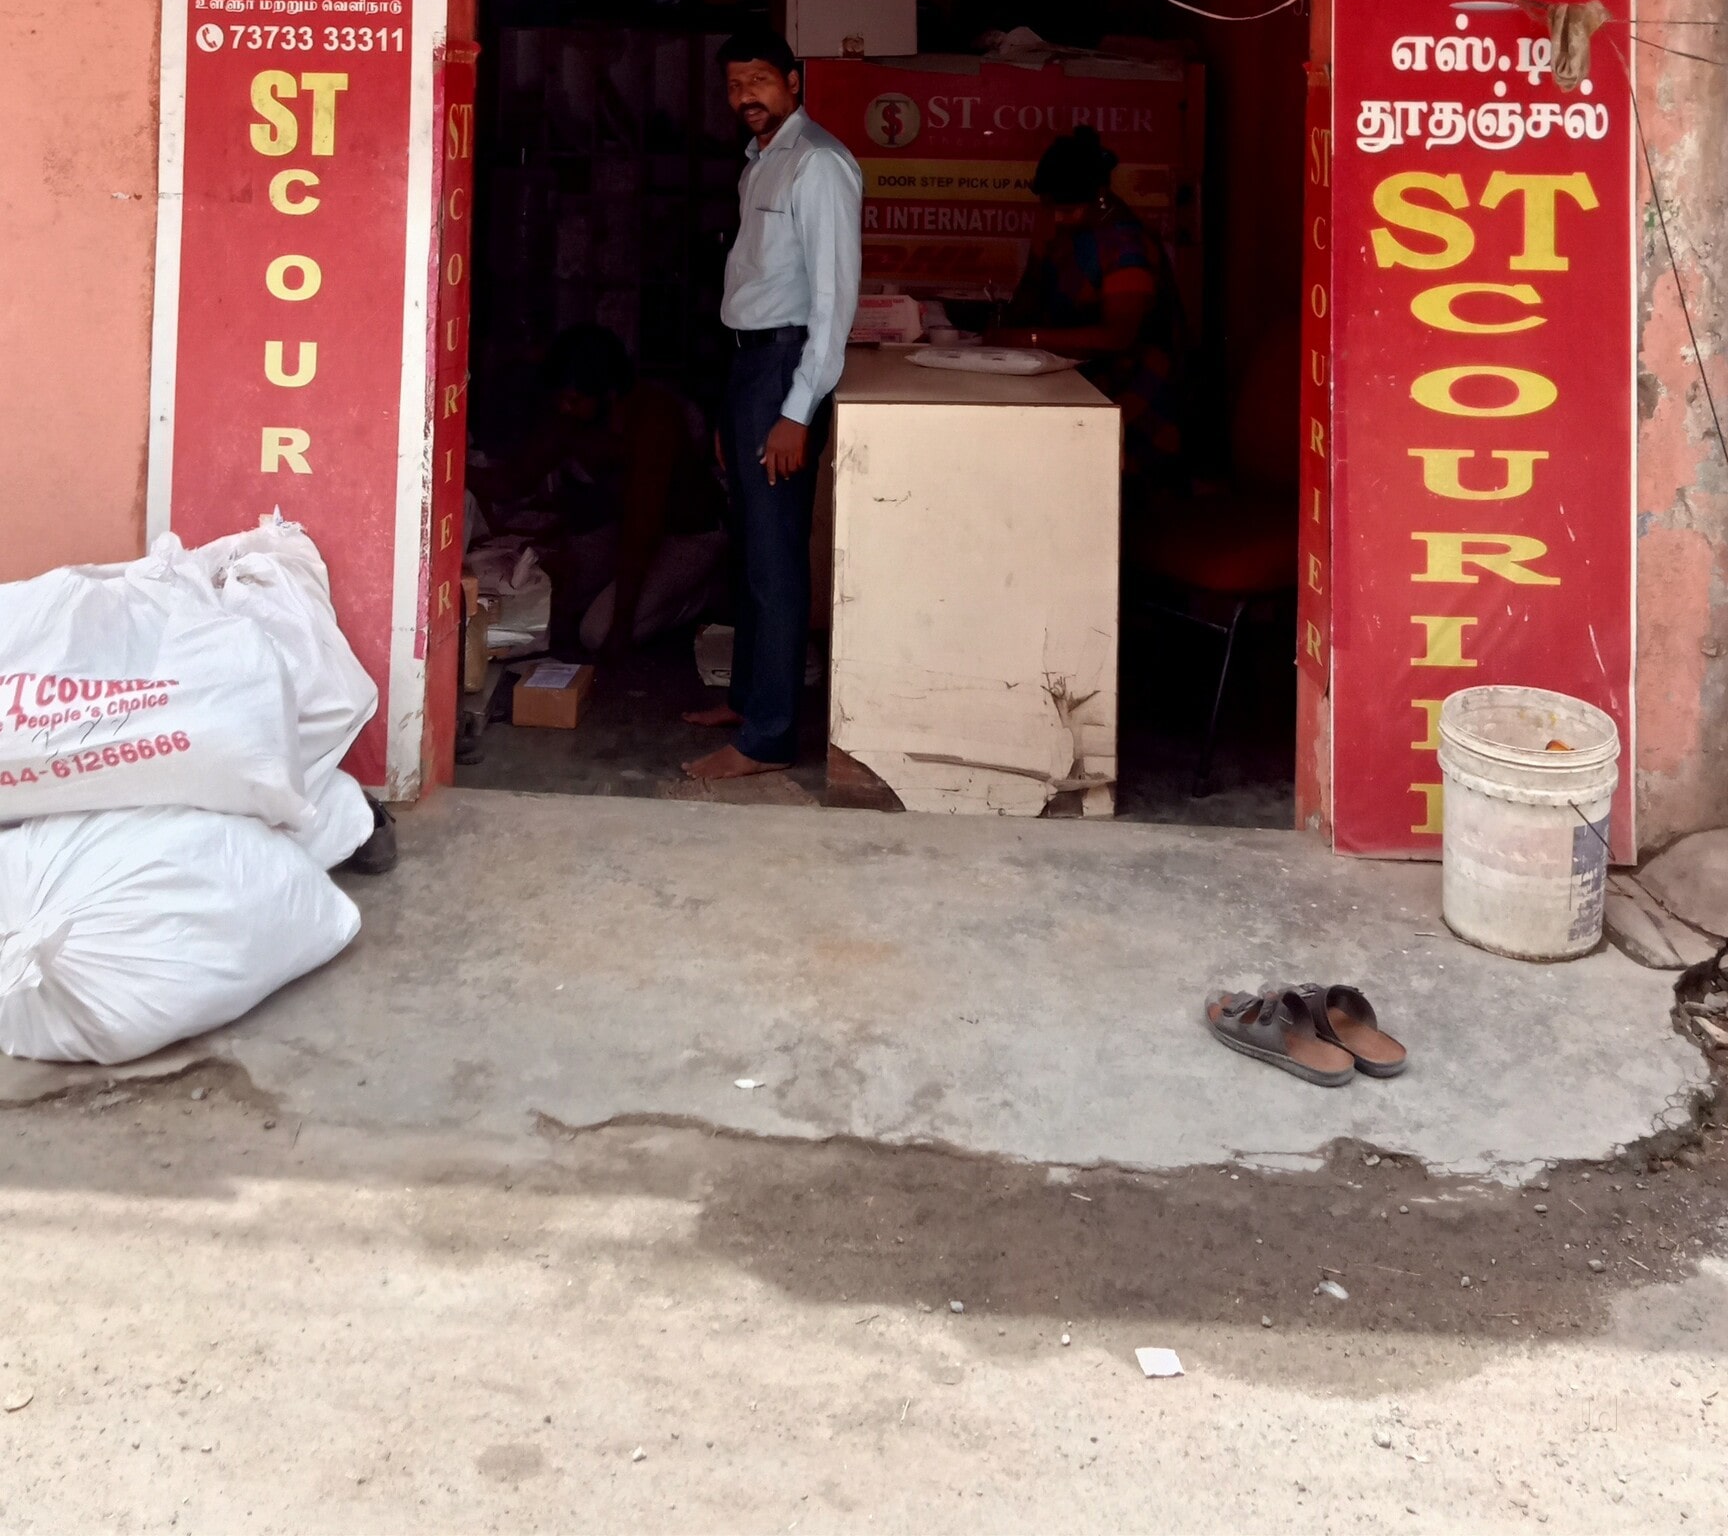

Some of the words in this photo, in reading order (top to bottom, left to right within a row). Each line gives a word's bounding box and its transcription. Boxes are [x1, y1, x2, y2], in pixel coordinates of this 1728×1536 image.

[229, 25, 314, 51] 73733
[323, 26, 403, 52] 33311
[1391, 13, 1552, 86] எஸ்.டி
[249, 69, 349, 157] ST
[448, 103, 473, 160] ST
[927, 95, 981, 129] ST
[992, 104, 1154, 133] COURIER
[1356, 78, 1609, 154] தூதஞ்சல்
[877, 175, 917, 188] DOOR
[920, 176, 954, 189] STEP
[958, 177, 990, 191] PICK
[992, 178, 1011, 191] UP
[1014, 178, 1034, 191] AN
[1311, 126, 1331, 187] ST
[886, 209, 1037, 234] INTERNATION
[1370, 170, 1600, 272] ST
[260, 169, 322, 475] COUR
[1408, 282, 1562, 834] COURI
[0, 673, 36, 716] T
[107, 693, 169, 717] Choice
